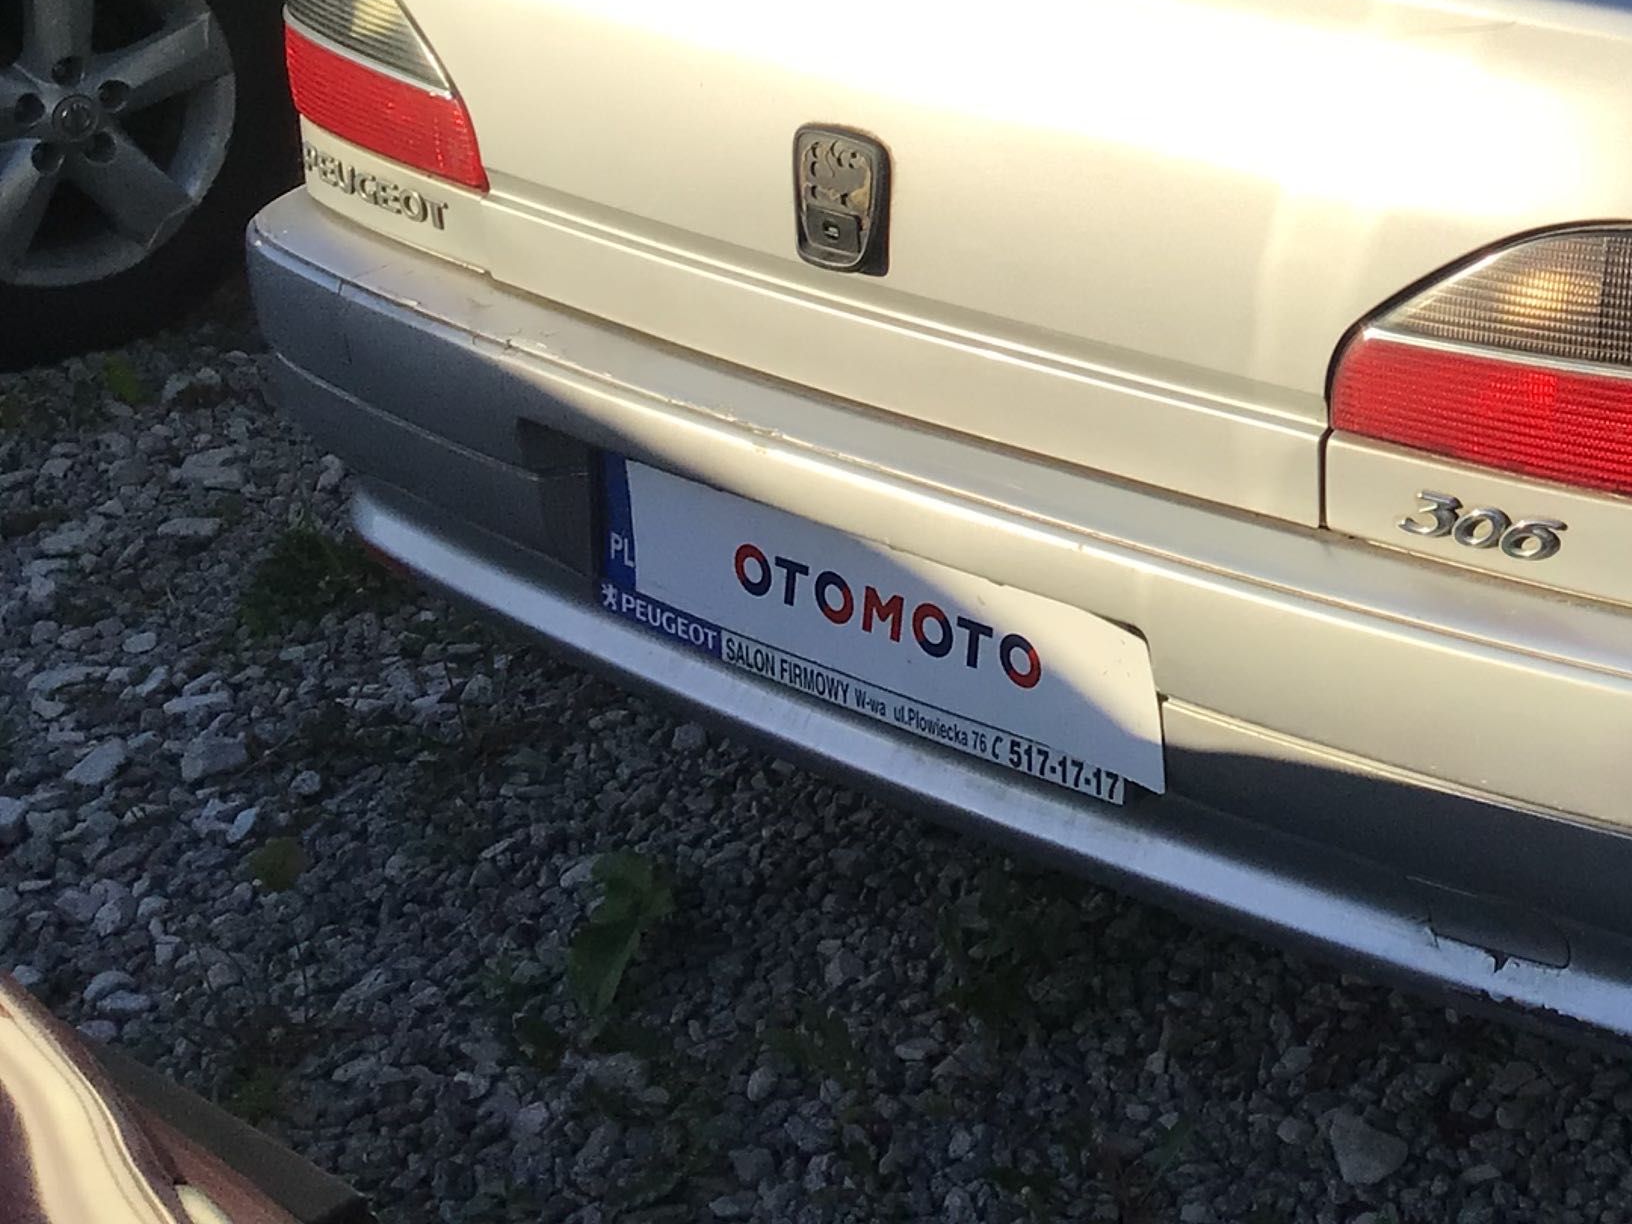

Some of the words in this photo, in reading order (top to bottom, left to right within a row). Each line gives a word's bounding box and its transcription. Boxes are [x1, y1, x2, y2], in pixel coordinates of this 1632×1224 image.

[303, 140, 450, 231] PEUGEOT
[610, 532, 636, 569] PL
[1397, 489, 1569, 562] 306
[620, 593, 719, 650] PEUGEOT
[733, 542, 1043, 690] OTOMOTO
[725, 637, 776, 677] SALON
[779, 658, 850, 706] FIRMOWY
[854, 687, 887, 717] W-wa
[971, 729, 988, 755] 76
[1008, 739, 1124, 803] 517-17-17
